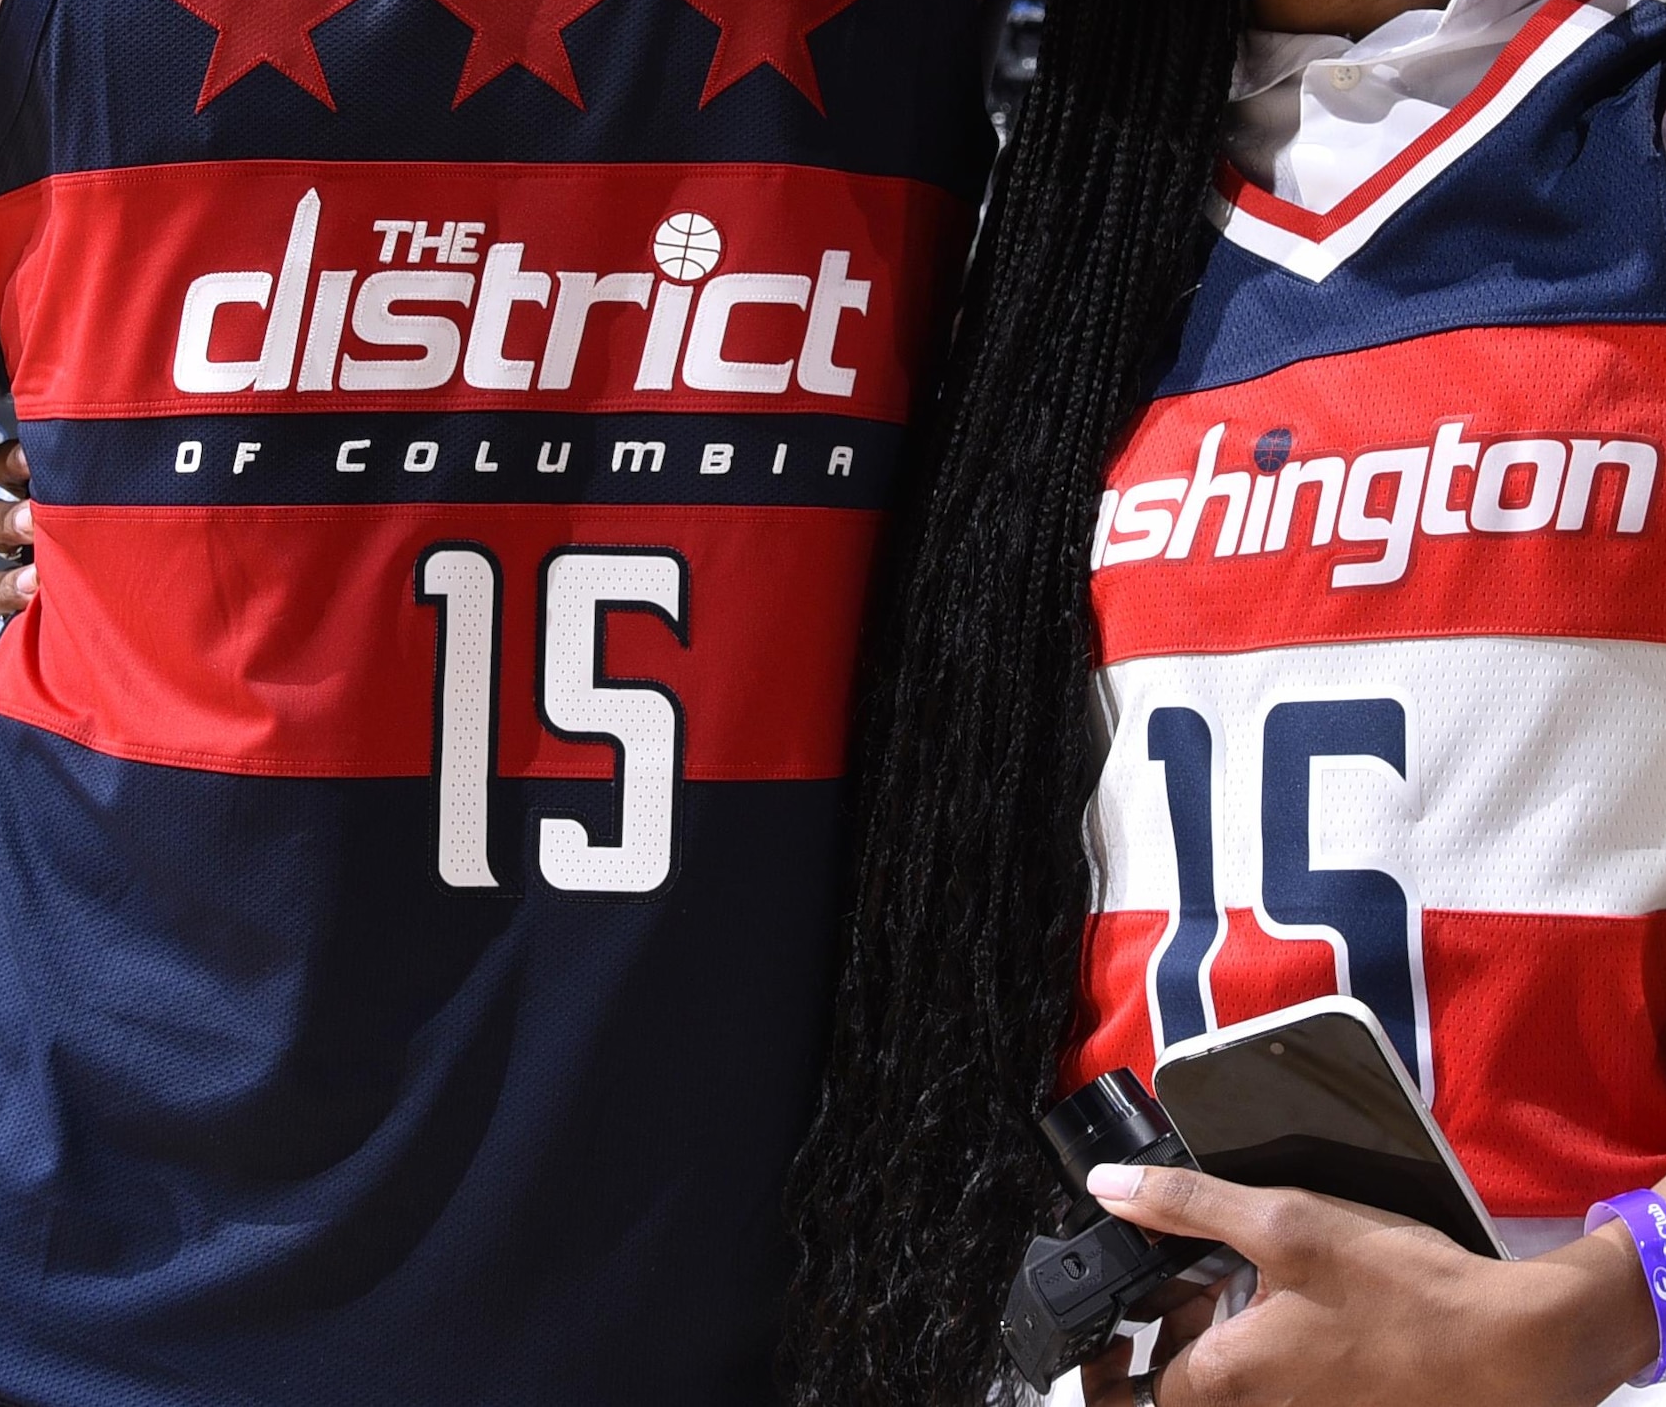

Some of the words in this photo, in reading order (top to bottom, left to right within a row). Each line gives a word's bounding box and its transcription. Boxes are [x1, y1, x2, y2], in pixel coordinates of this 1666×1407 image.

[172, 187, 873, 398] district
[373, 220, 486, 265] THE
[174, 440, 263, 475] OF
[335, 438, 855, 477] COLUMBIA
[413, 539, 693, 903] 15
[1145, 695, 1431, 1107] 15
